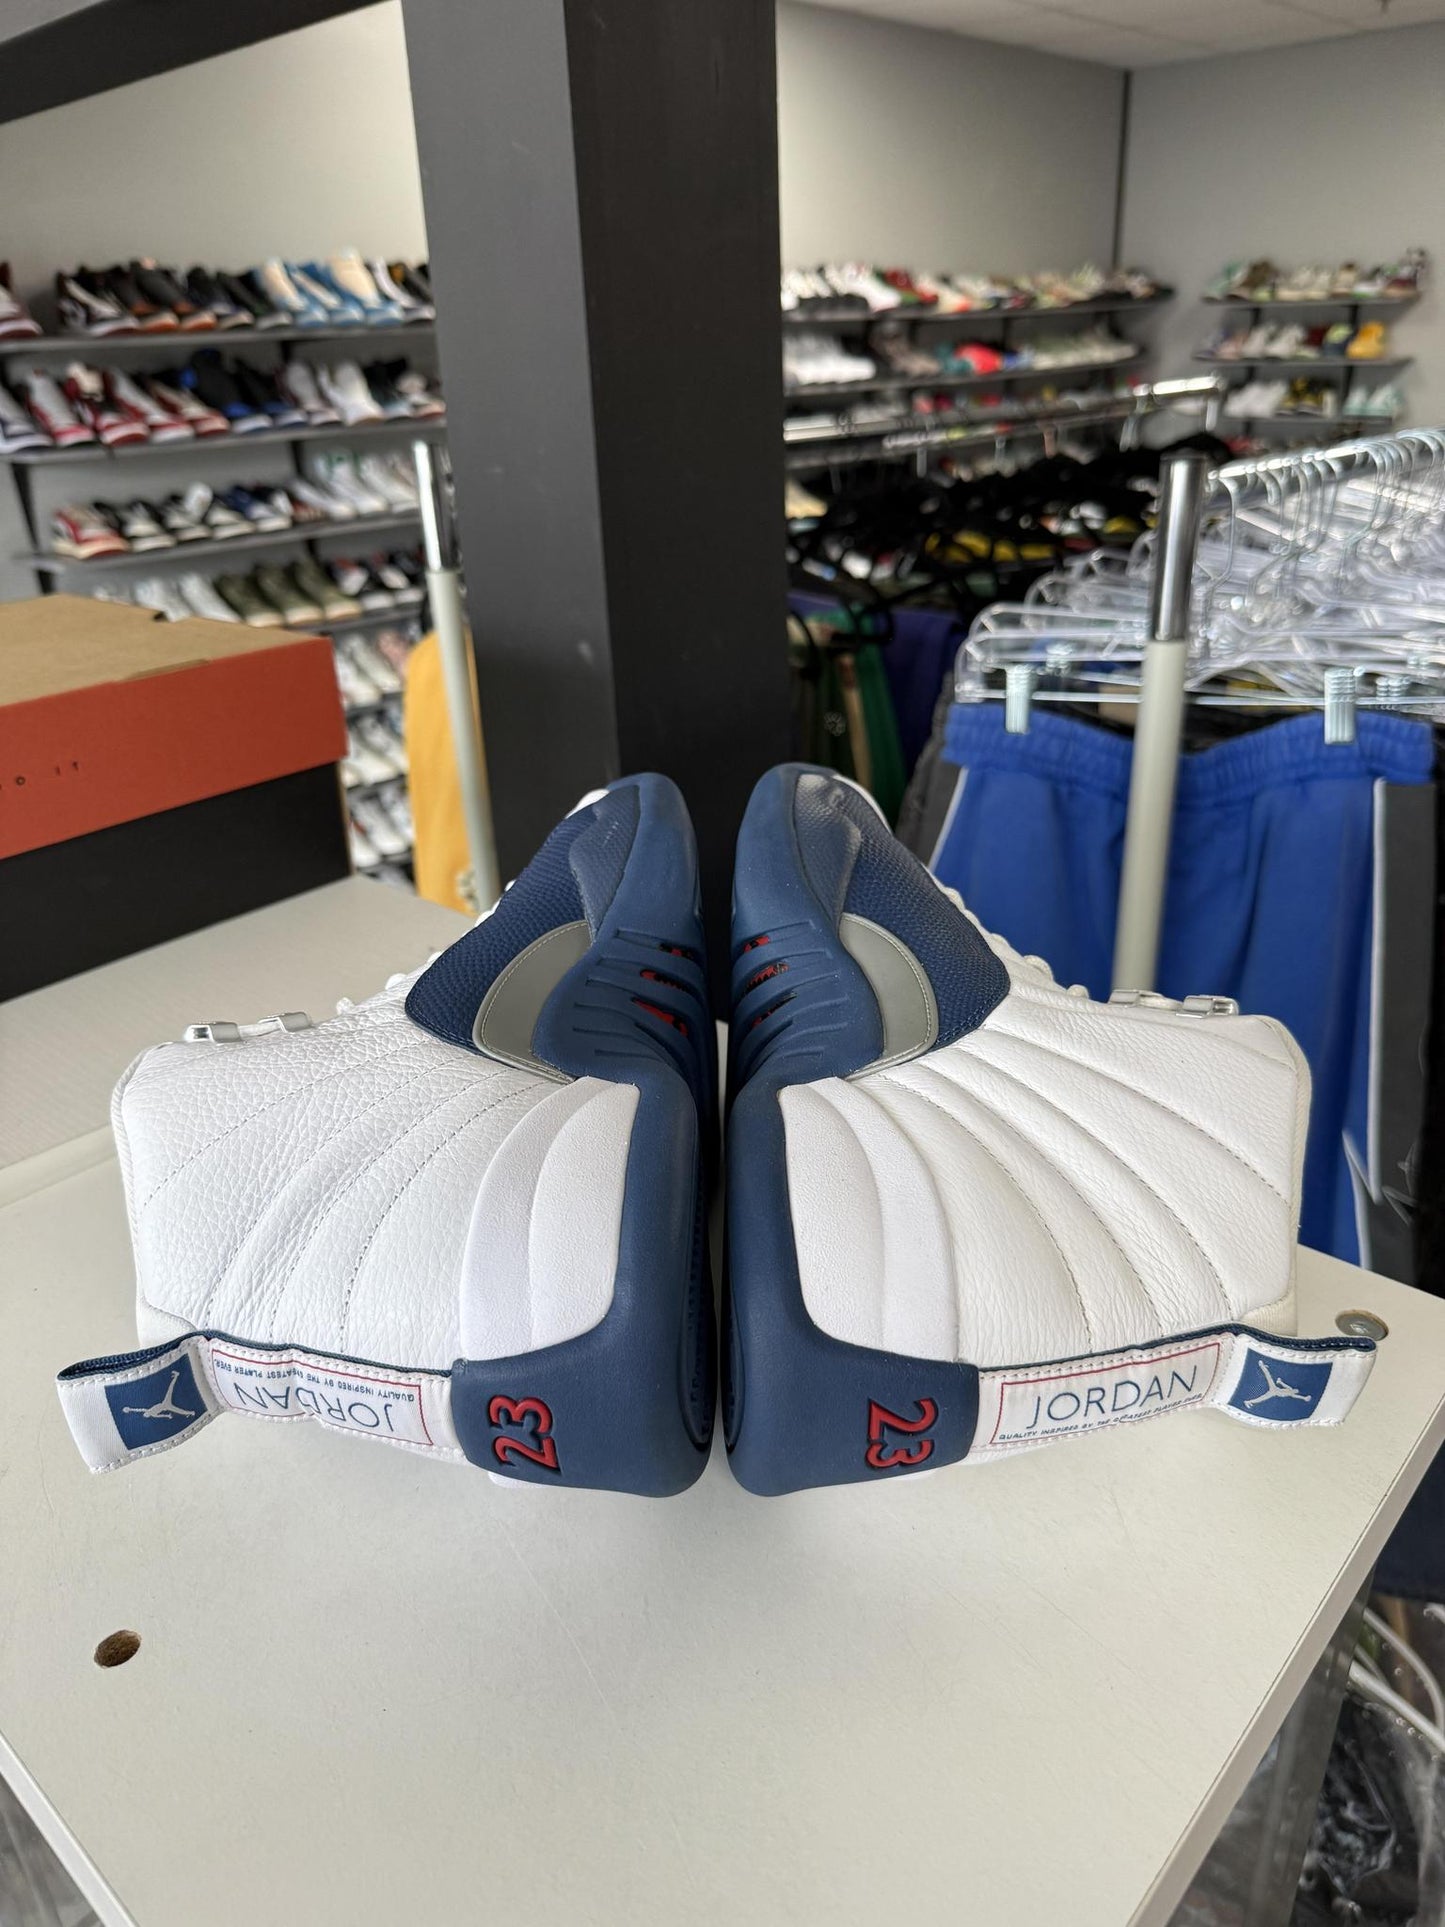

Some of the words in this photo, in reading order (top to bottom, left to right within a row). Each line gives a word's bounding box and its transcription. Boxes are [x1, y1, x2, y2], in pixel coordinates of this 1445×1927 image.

[234, 1367, 263, 1378] PLAYER
[306, 1374, 320, 1384] THE
[324, 1378, 334, 1386] BY
[337, 1381, 374, 1395] INSPIRED
[377, 1390, 415, 1402] QUALITY
[1026, 1365, 1197, 1429] JORDAN
[233, 1382, 394, 1432] JORDAN
[487, 1395, 562, 1474] 23
[866, 1398, 938, 1469] 23
[998, 1431, 1037, 1440] QUALITY
[1040, 1425, 1079, 1435] INSPIRED
